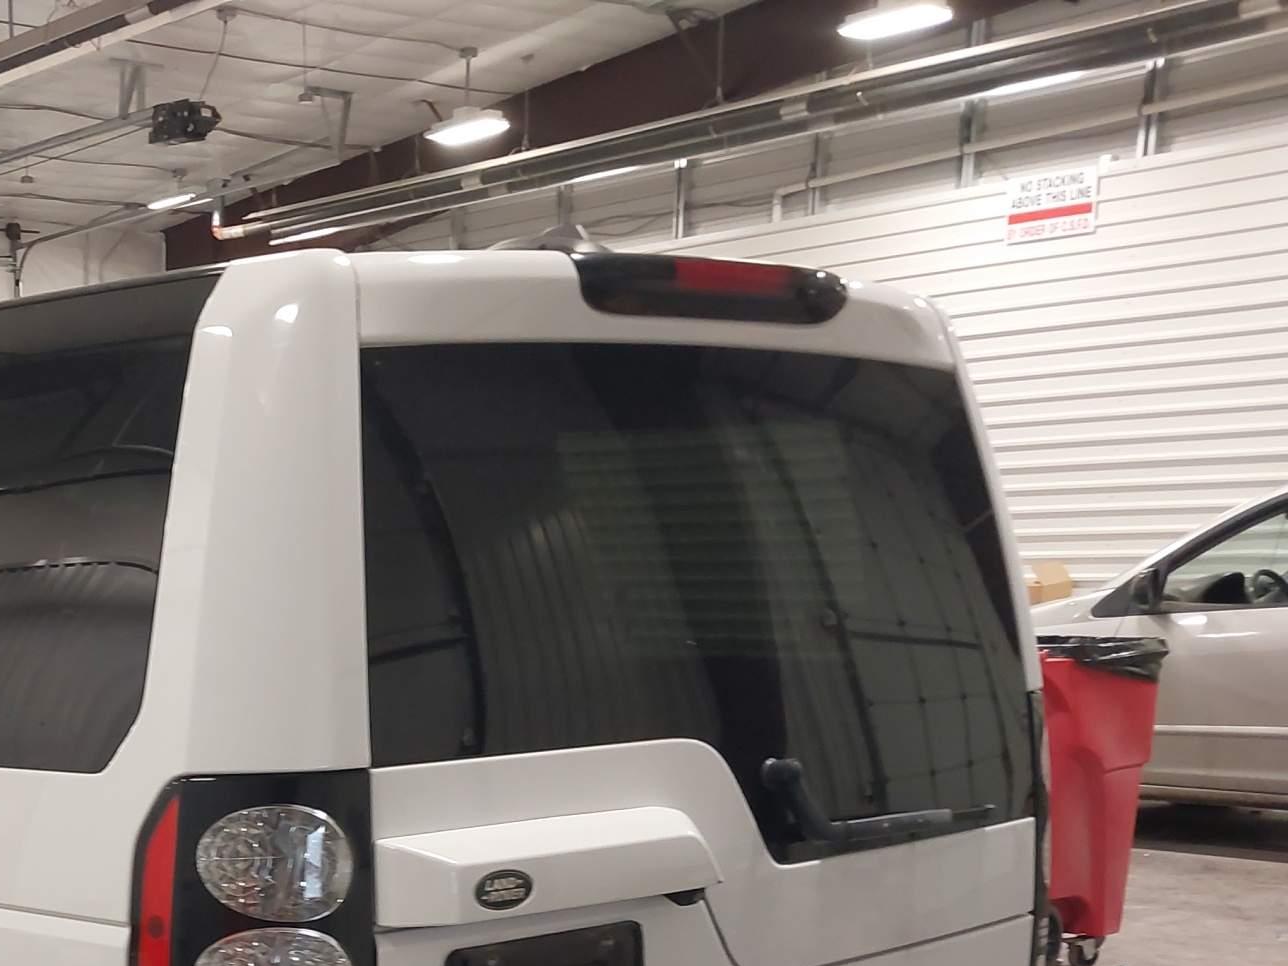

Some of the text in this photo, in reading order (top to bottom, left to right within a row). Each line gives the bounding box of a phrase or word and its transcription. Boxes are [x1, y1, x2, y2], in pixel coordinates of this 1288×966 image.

[1020, 171, 1084, 192] NO STACKING
[1011, 185, 1092, 209] ABOVE THIS LINE
[1019, 224, 1046, 238] ORDER
[1047, 220, 1060, 234] OF
